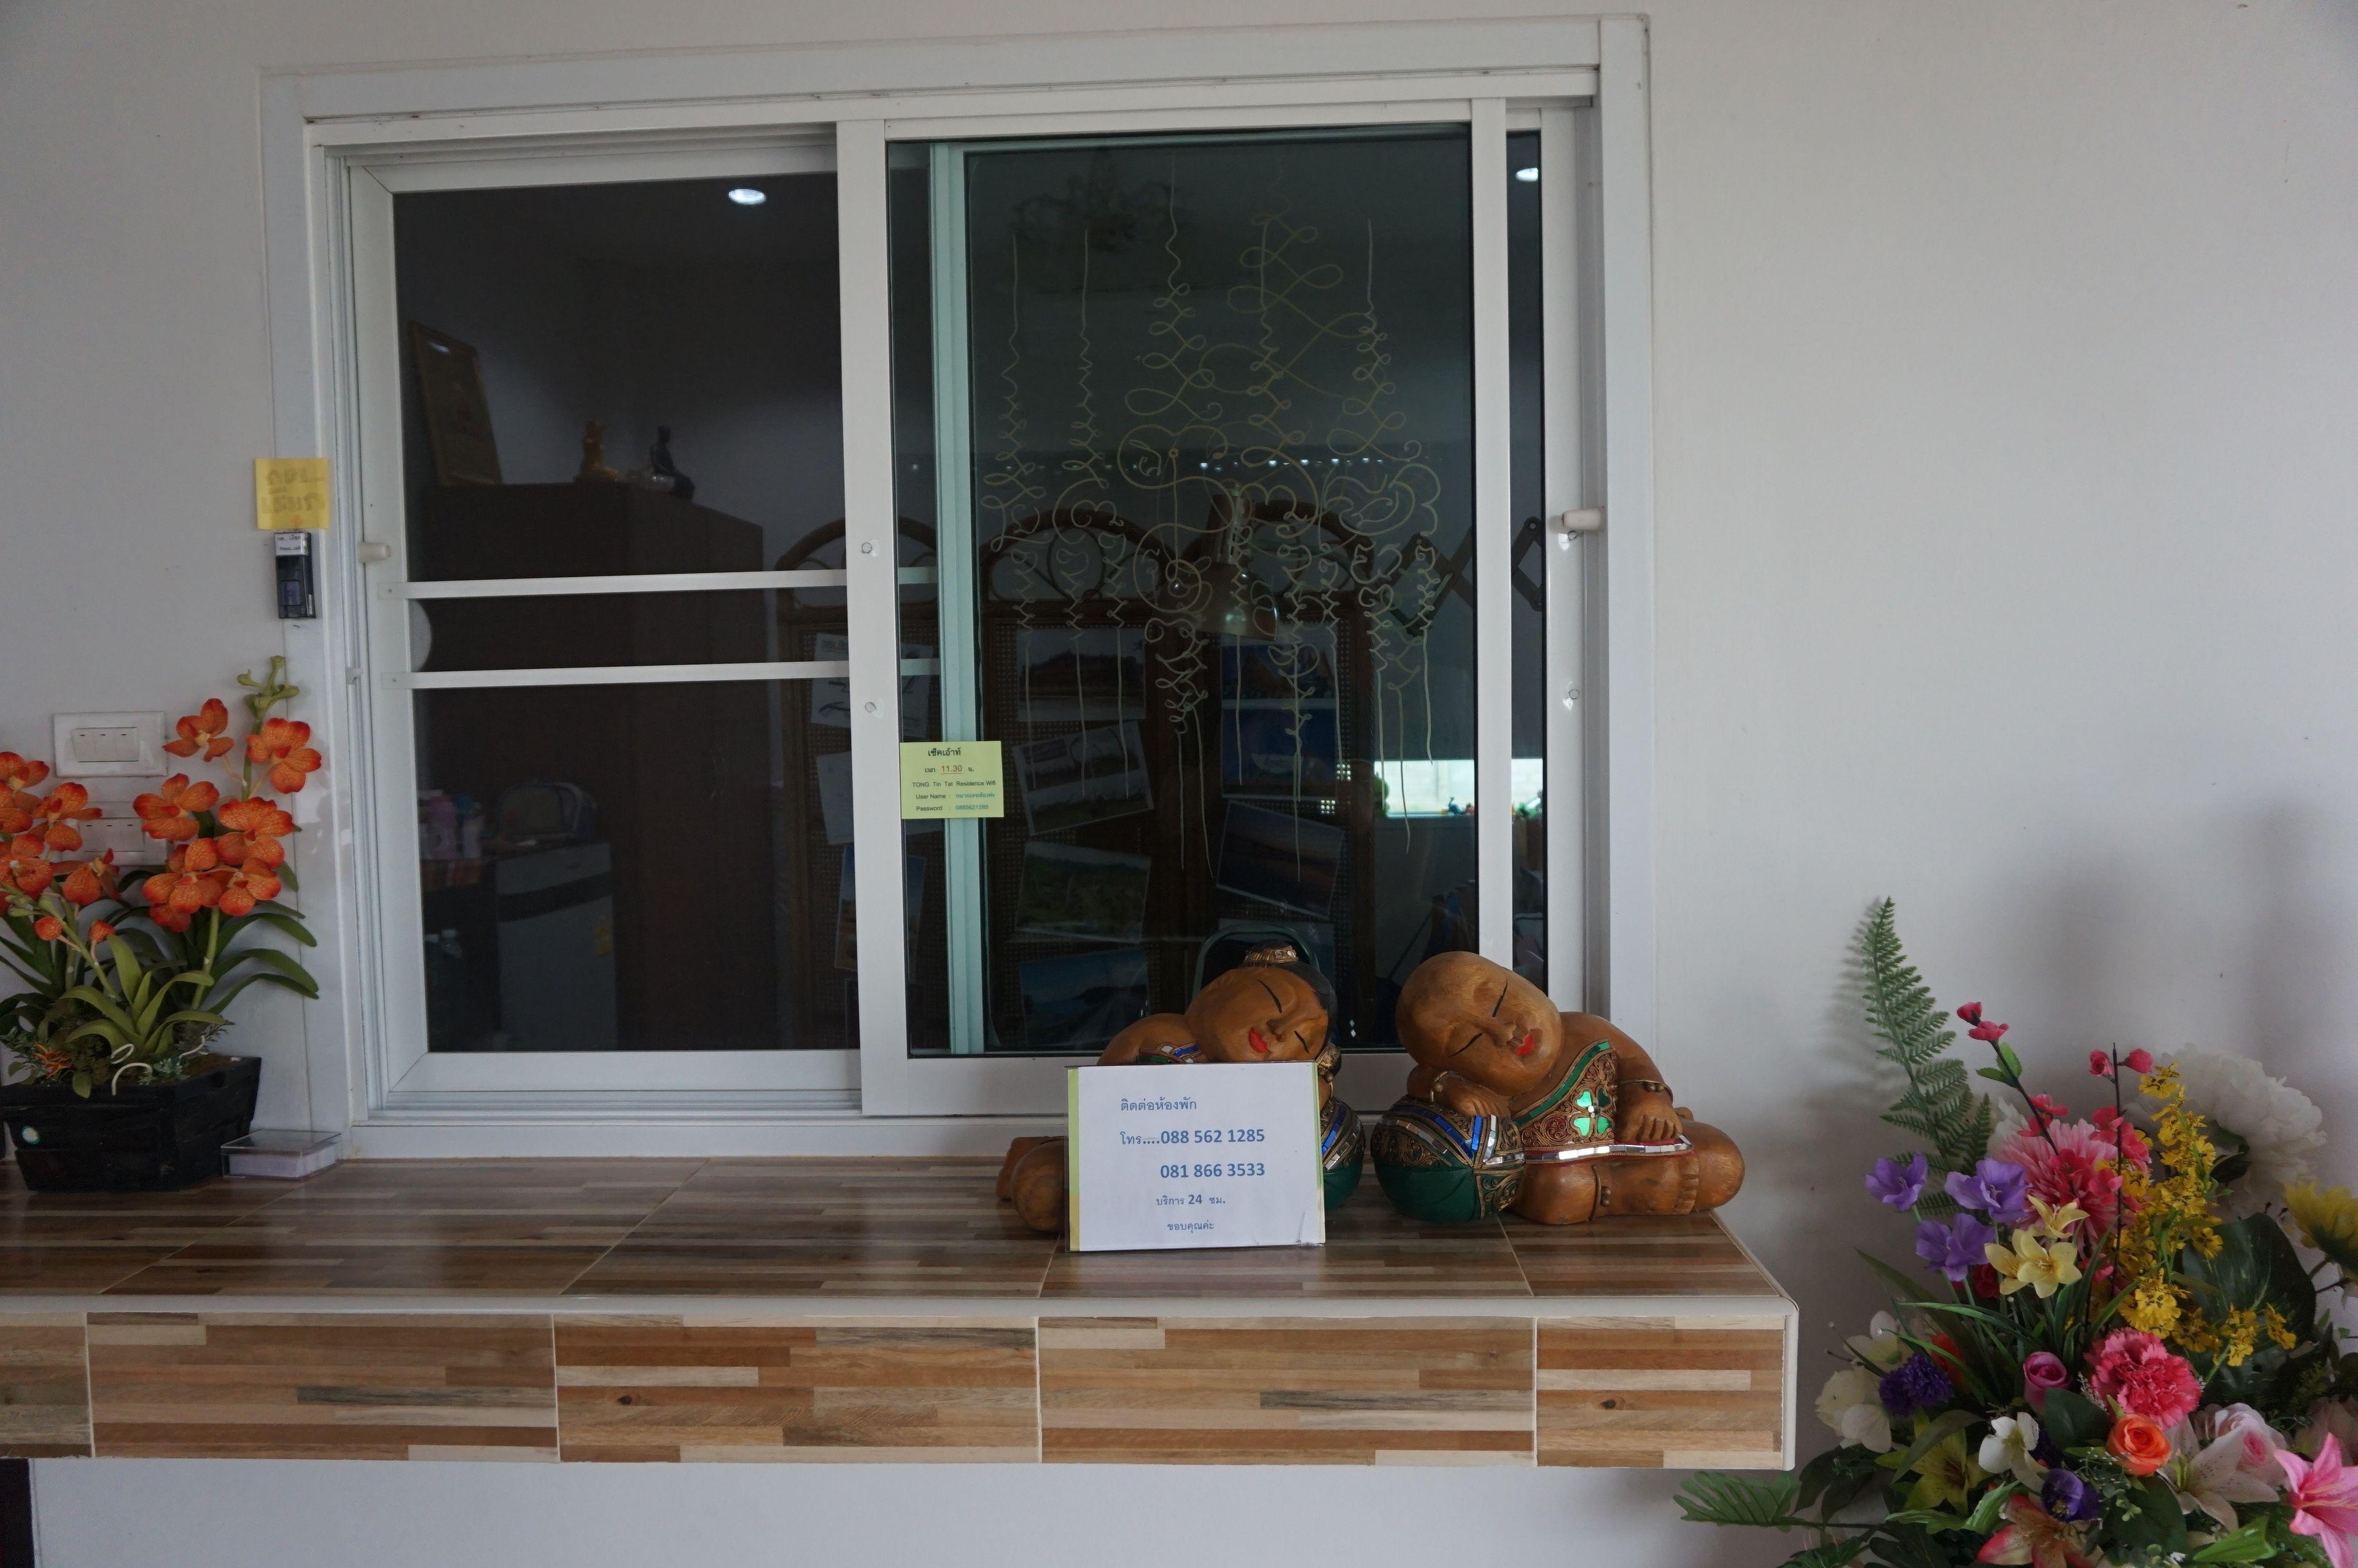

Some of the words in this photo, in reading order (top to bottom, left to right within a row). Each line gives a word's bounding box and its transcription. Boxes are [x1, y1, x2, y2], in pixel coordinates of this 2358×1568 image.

[1121, 1096, 1197, 1111] ติดต่อห้องพัก
[1194, 1130, 1223, 1143] 562
[1228, 1128, 1266, 1142] 1285
[1160, 1164, 1189, 1178] 081
[1194, 1163, 1222, 1178] 866
[1227, 1163, 1266, 1176] 3533
[1156, 1195, 1185, 1205] บริการ
[1188, 1194, 1202, 1205] 24
[1167, 1220, 1215, 1233] ขอบคุณค่ะ
